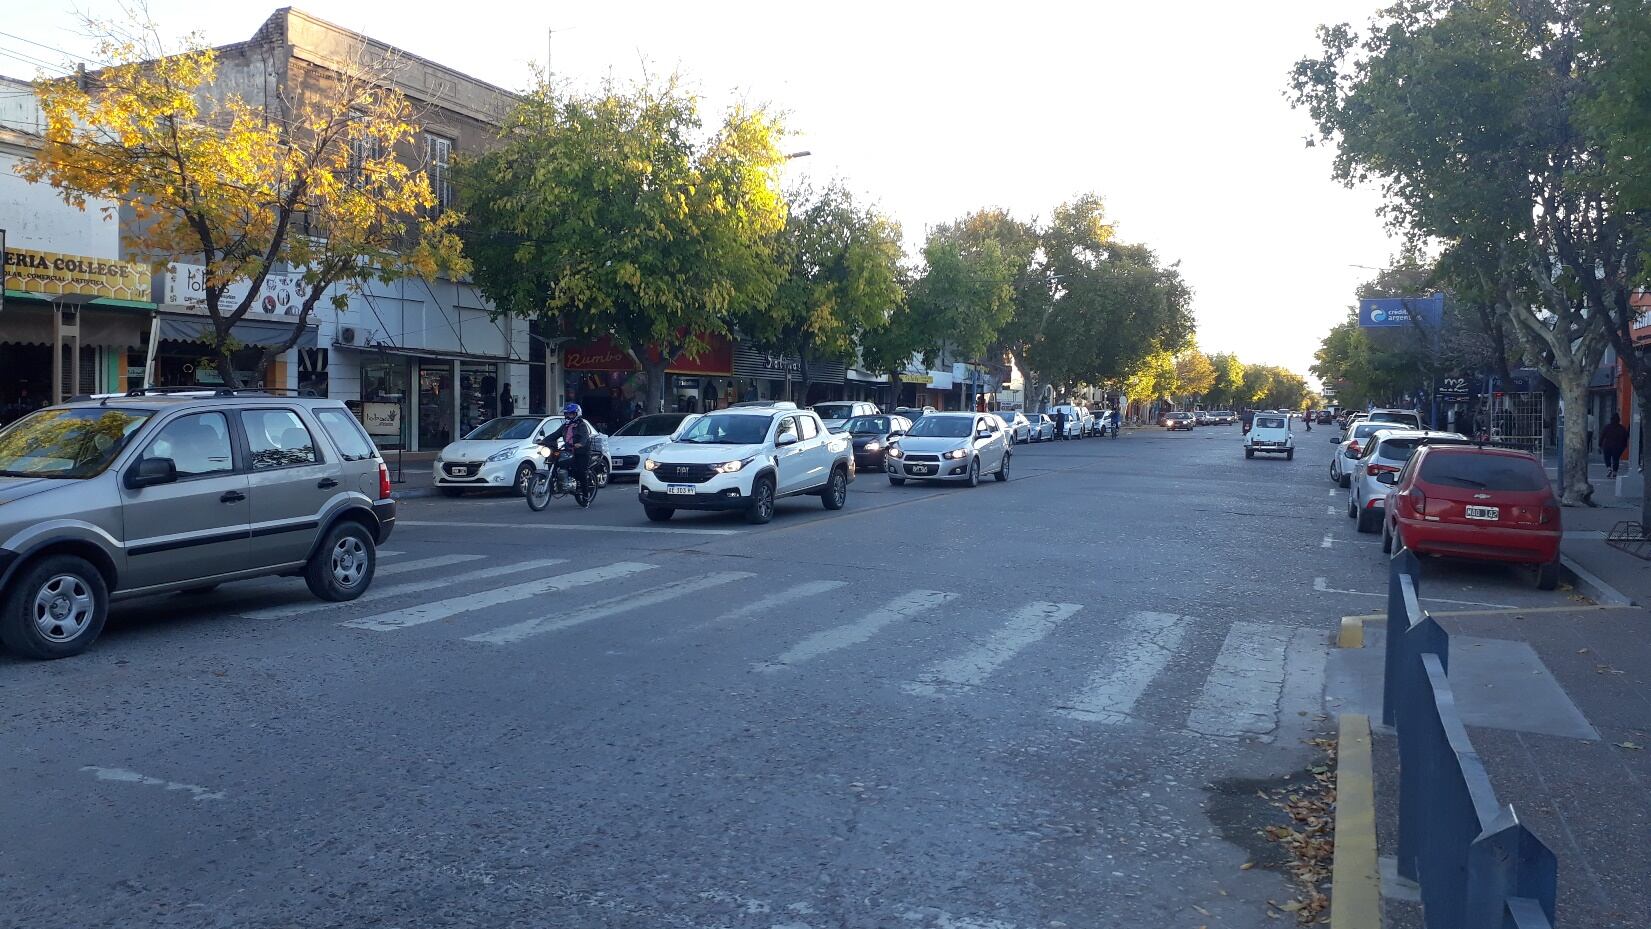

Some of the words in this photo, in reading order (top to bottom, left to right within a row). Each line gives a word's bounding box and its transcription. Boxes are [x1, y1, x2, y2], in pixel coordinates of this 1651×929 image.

[53, 257, 130, 278] COLLEGE
[27, 272, 66, 282] COMERCIAL
[567, 351, 623, 367] Rumbo
